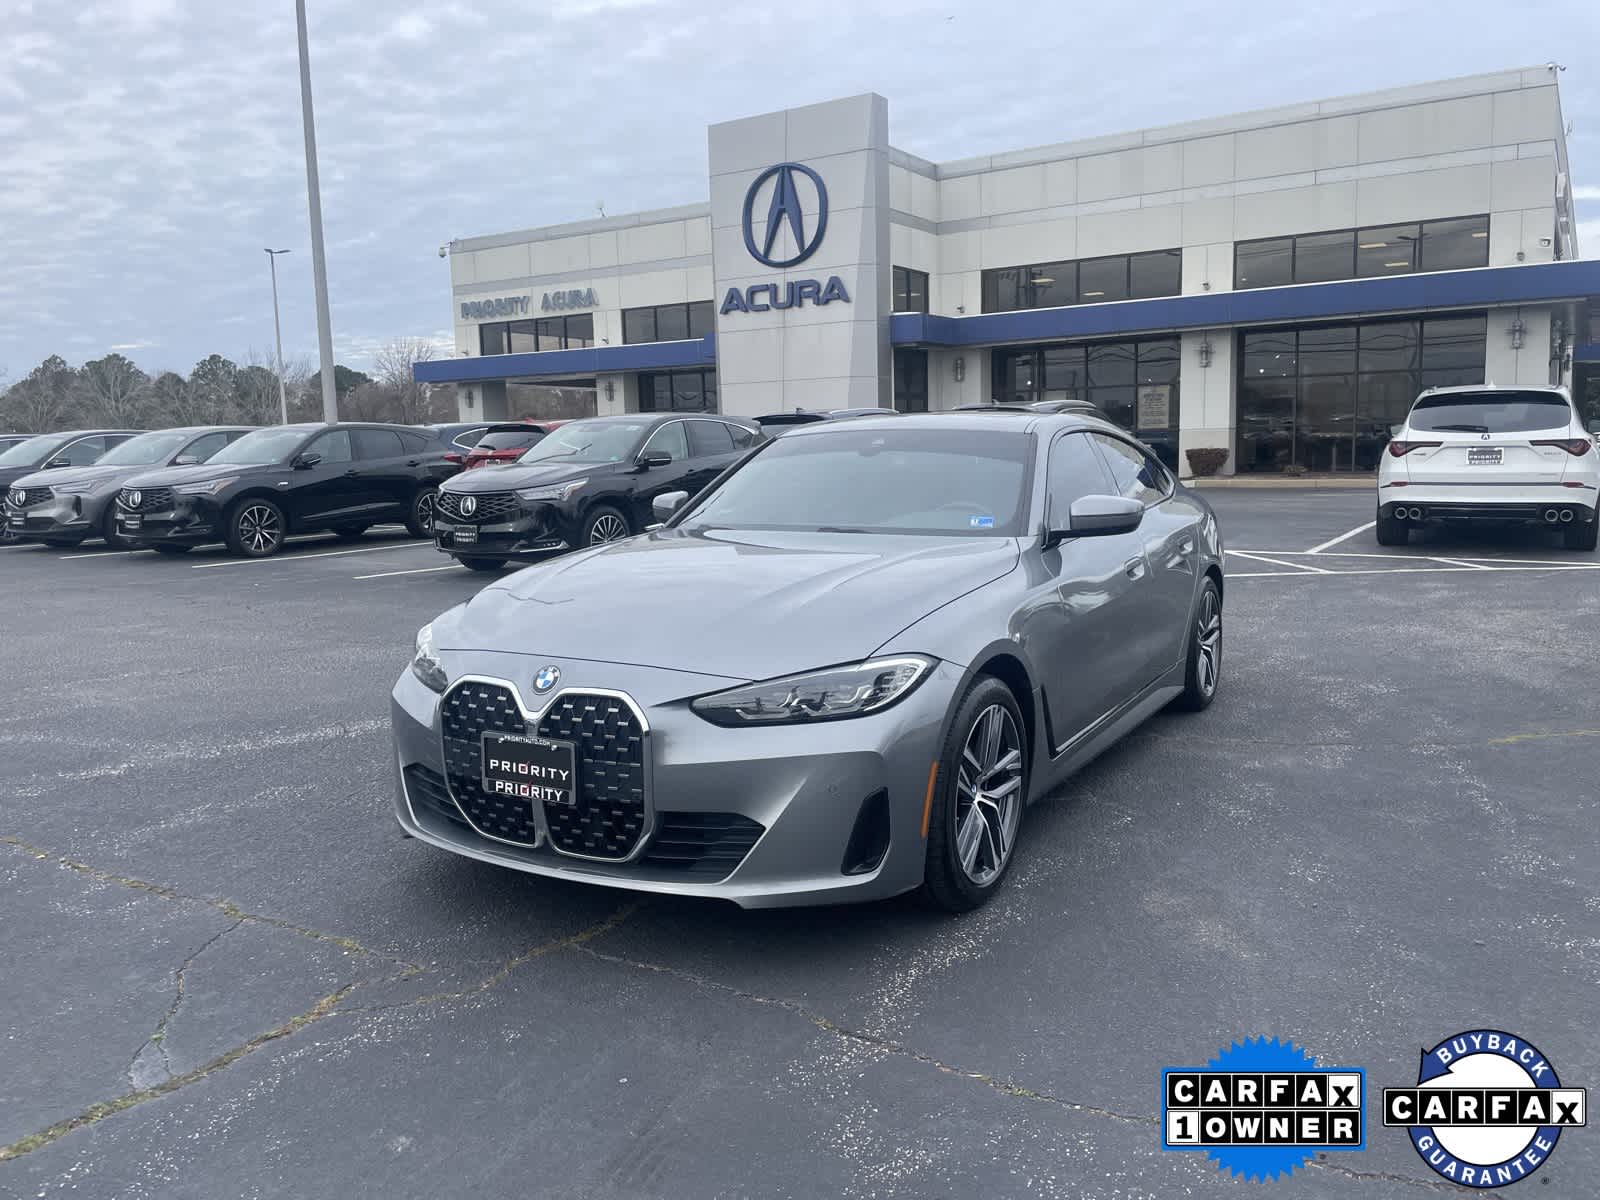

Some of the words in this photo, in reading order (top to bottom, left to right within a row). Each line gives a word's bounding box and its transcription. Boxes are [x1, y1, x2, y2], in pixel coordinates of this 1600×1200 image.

[541, 287, 600, 312] ACURA
[720, 275, 851, 315] ACURA
[489, 759, 569, 781] PRIORITY
[495, 781, 563, 802] PRIORITY
